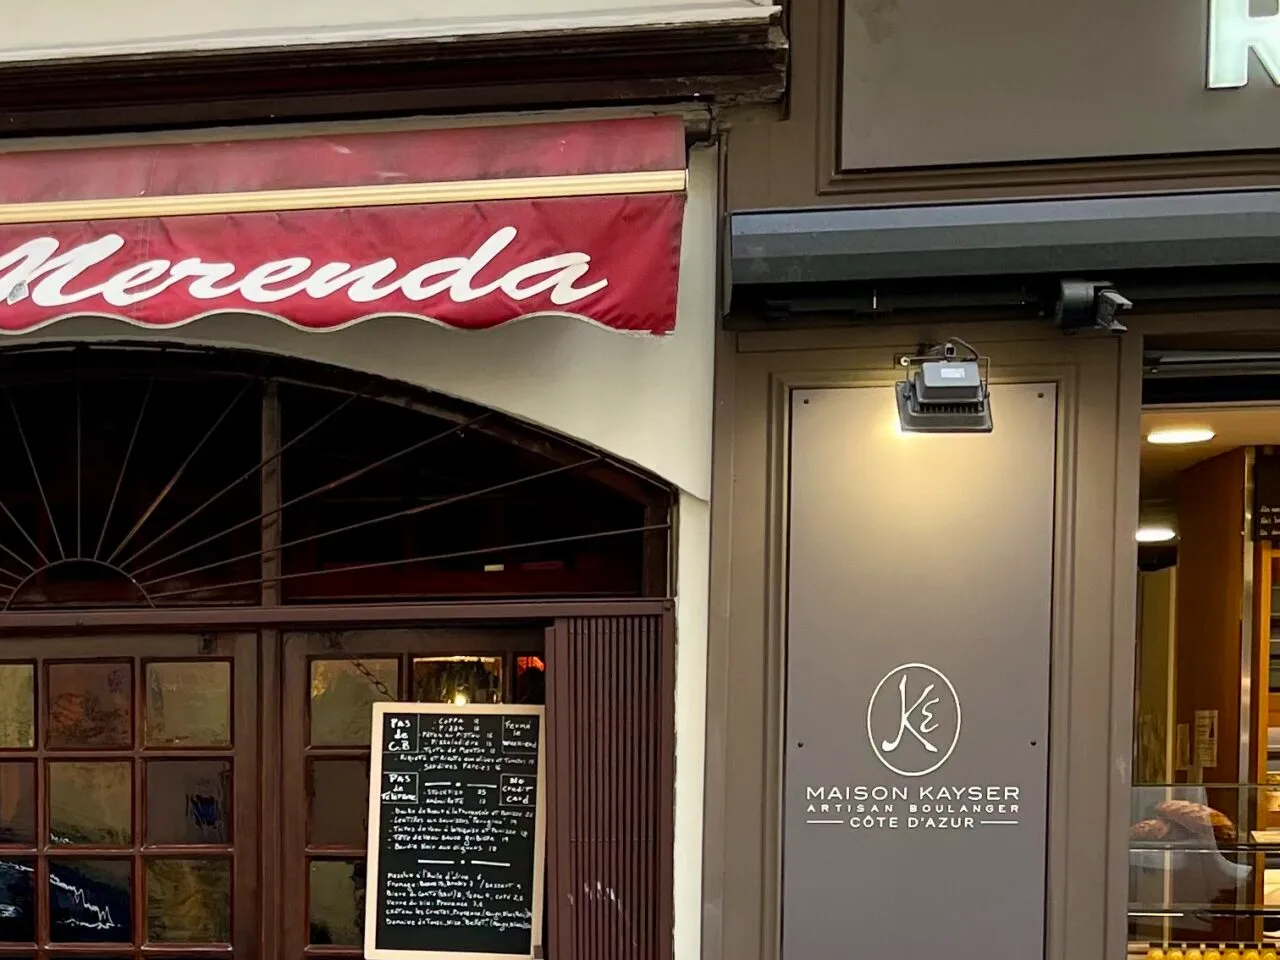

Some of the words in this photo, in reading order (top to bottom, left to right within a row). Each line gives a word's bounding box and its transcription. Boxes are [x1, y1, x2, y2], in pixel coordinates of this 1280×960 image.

[806, 786, 908, 800] MAISON
[919, 786, 1019, 800] KAYSER
[807, 804, 893, 813] ARTISAN
[909, 804, 1019, 813] BOULANGER
[849, 815, 898, 828] CÔTE
[908, 817, 974, 828] D'AZUR
